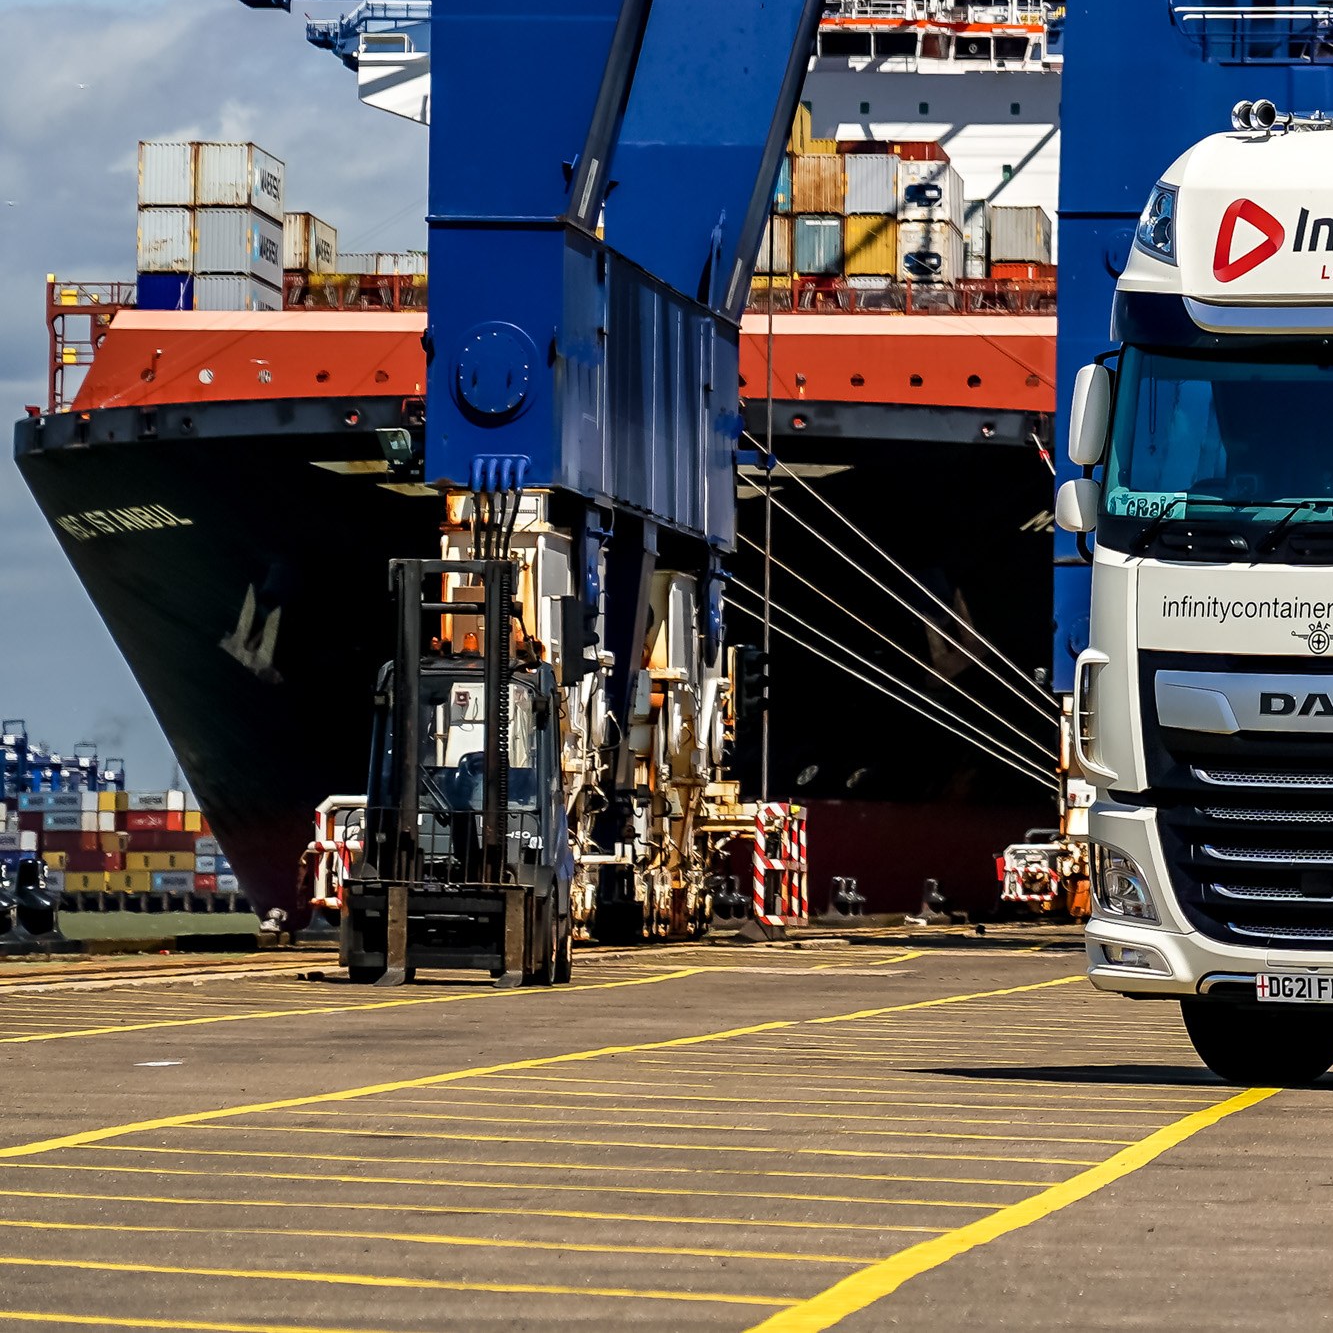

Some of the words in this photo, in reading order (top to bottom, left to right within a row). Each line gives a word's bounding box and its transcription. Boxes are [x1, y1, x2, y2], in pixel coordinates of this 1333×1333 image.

[79, 503, 194, 535] ISTANBUL
[1308, 621, 1331, 632] DAF
[1268, 976, 1312, 998] DG21
